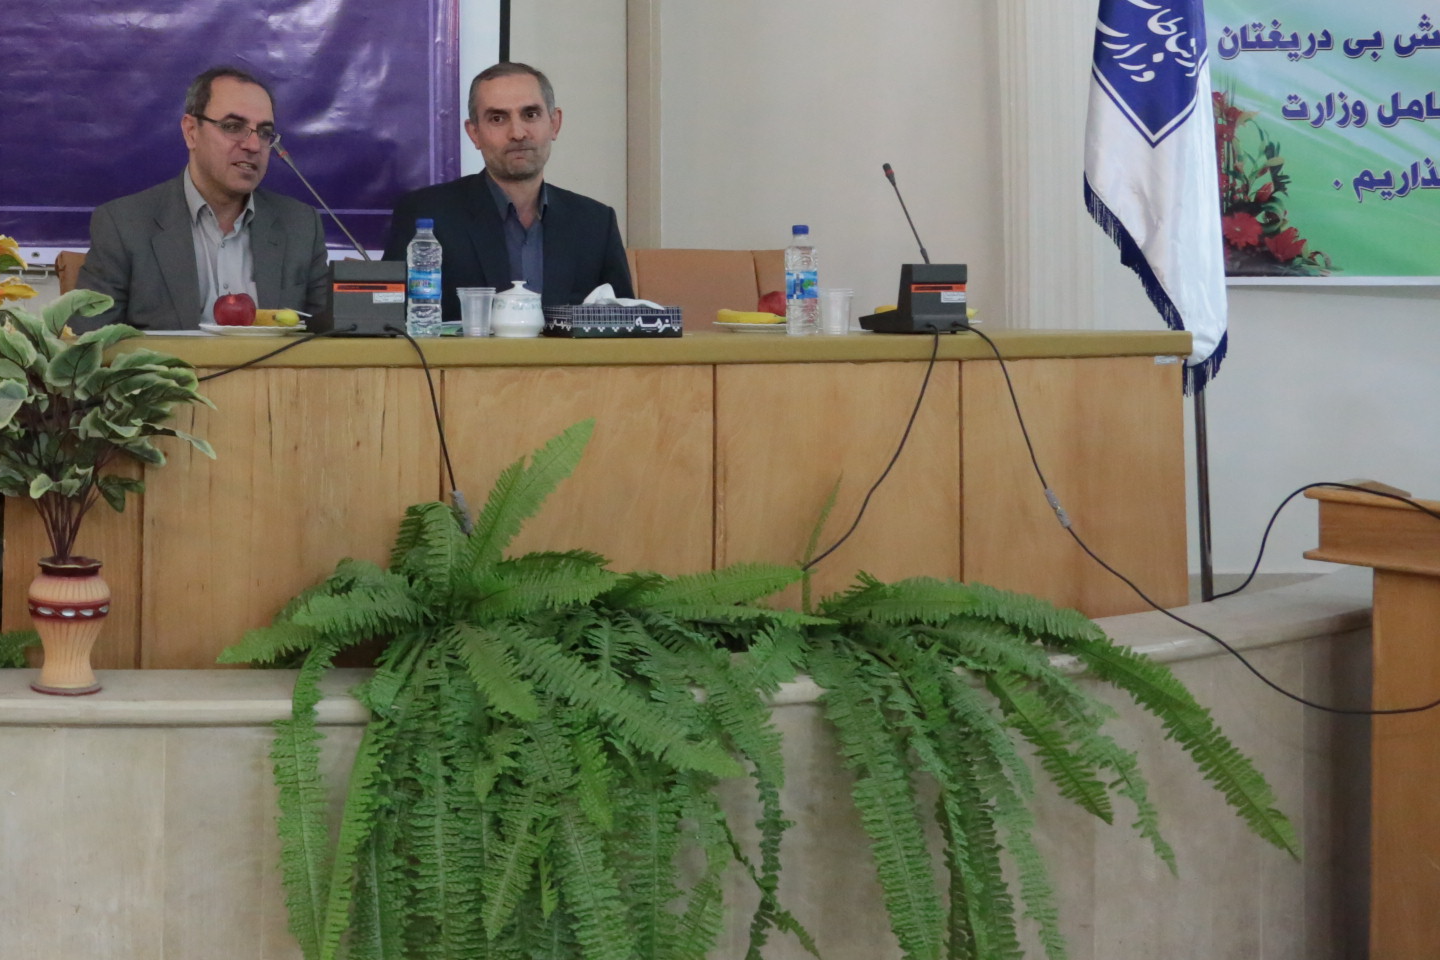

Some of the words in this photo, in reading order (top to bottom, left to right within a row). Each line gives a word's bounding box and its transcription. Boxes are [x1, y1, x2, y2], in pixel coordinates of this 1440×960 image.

[1217, 18, 1334, 61] دریغتان
[1343, 30, 1384, 61] بی
[1281, 91, 1368, 128] وزارت
[1377, 91, 1440, 128] امل
[1352, 157, 1440, 203] ذاریم
